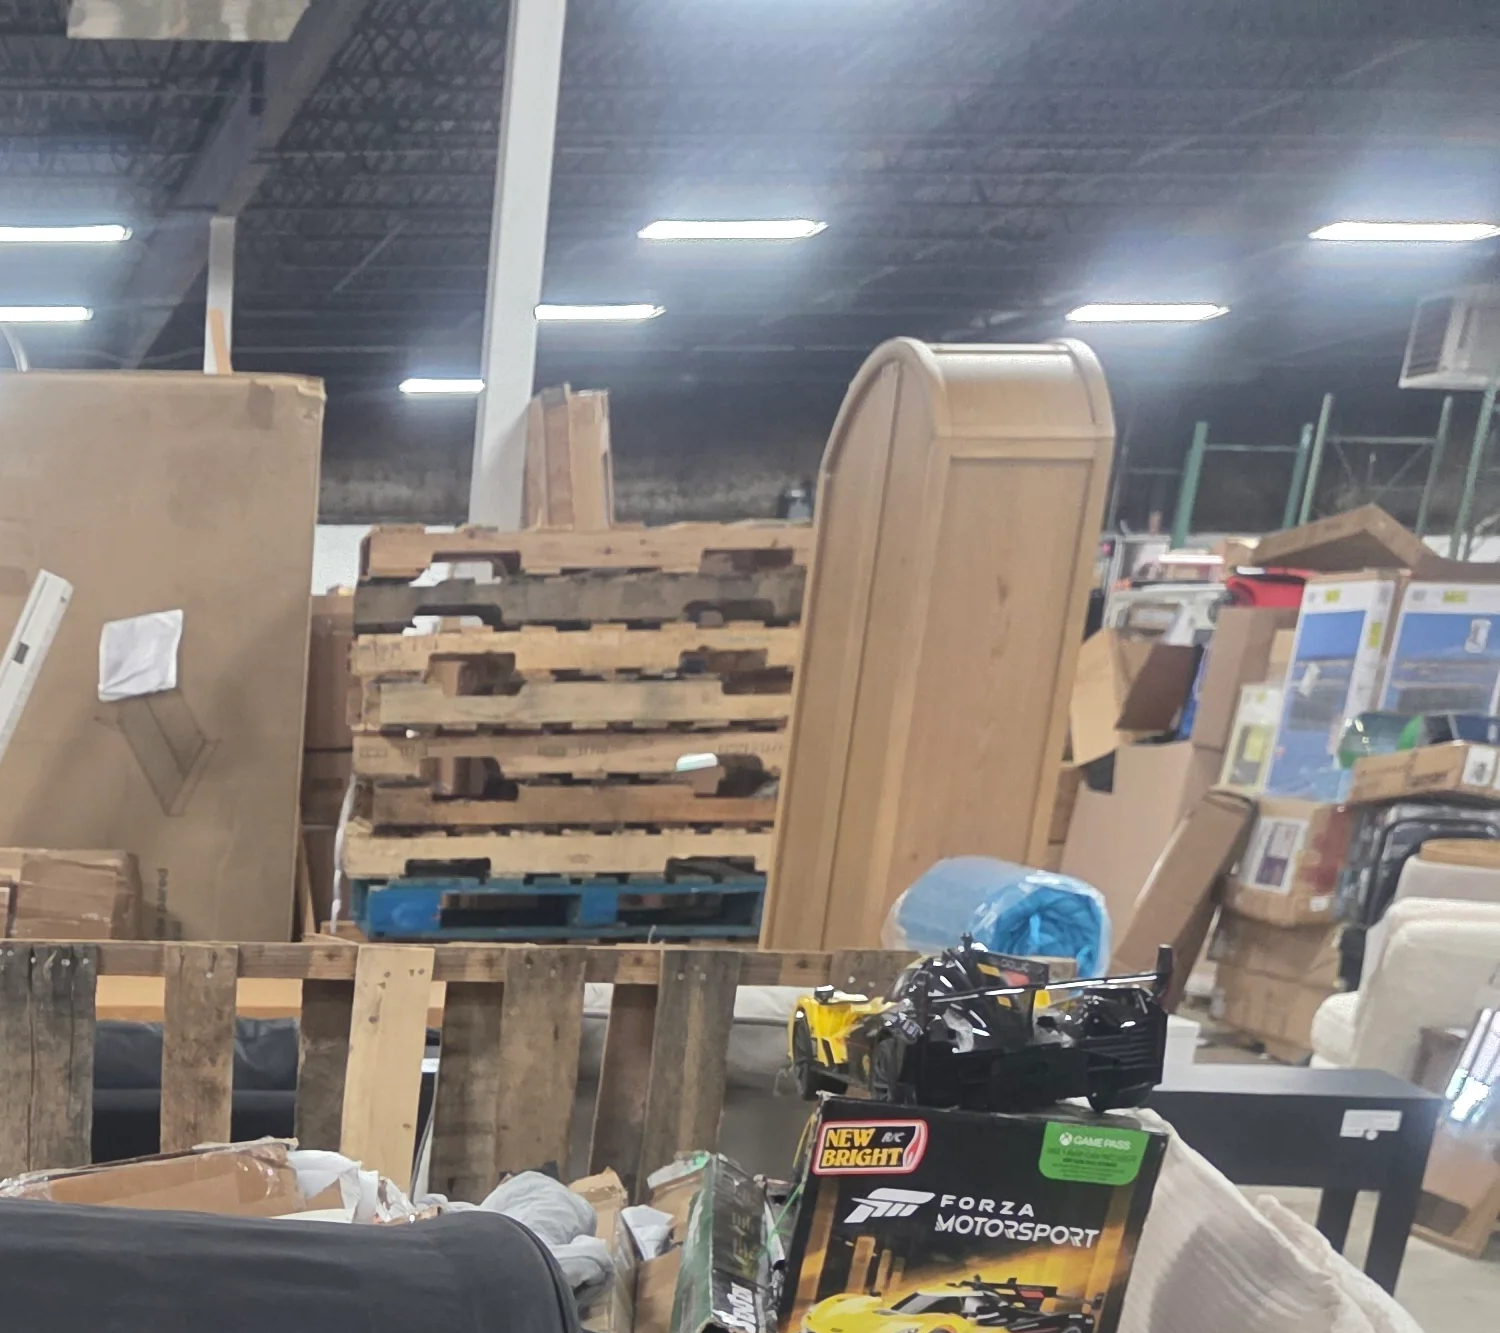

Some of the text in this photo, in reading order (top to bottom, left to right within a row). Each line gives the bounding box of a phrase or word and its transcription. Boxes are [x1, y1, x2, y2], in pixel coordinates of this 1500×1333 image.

[825, 1128, 876, 1148] NEW
[820, 1147, 904, 1168] BRIGHT
[940, 1194, 1035, 1218] FORZA
[934, 1213, 1100, 1249] MOTORSPORT
